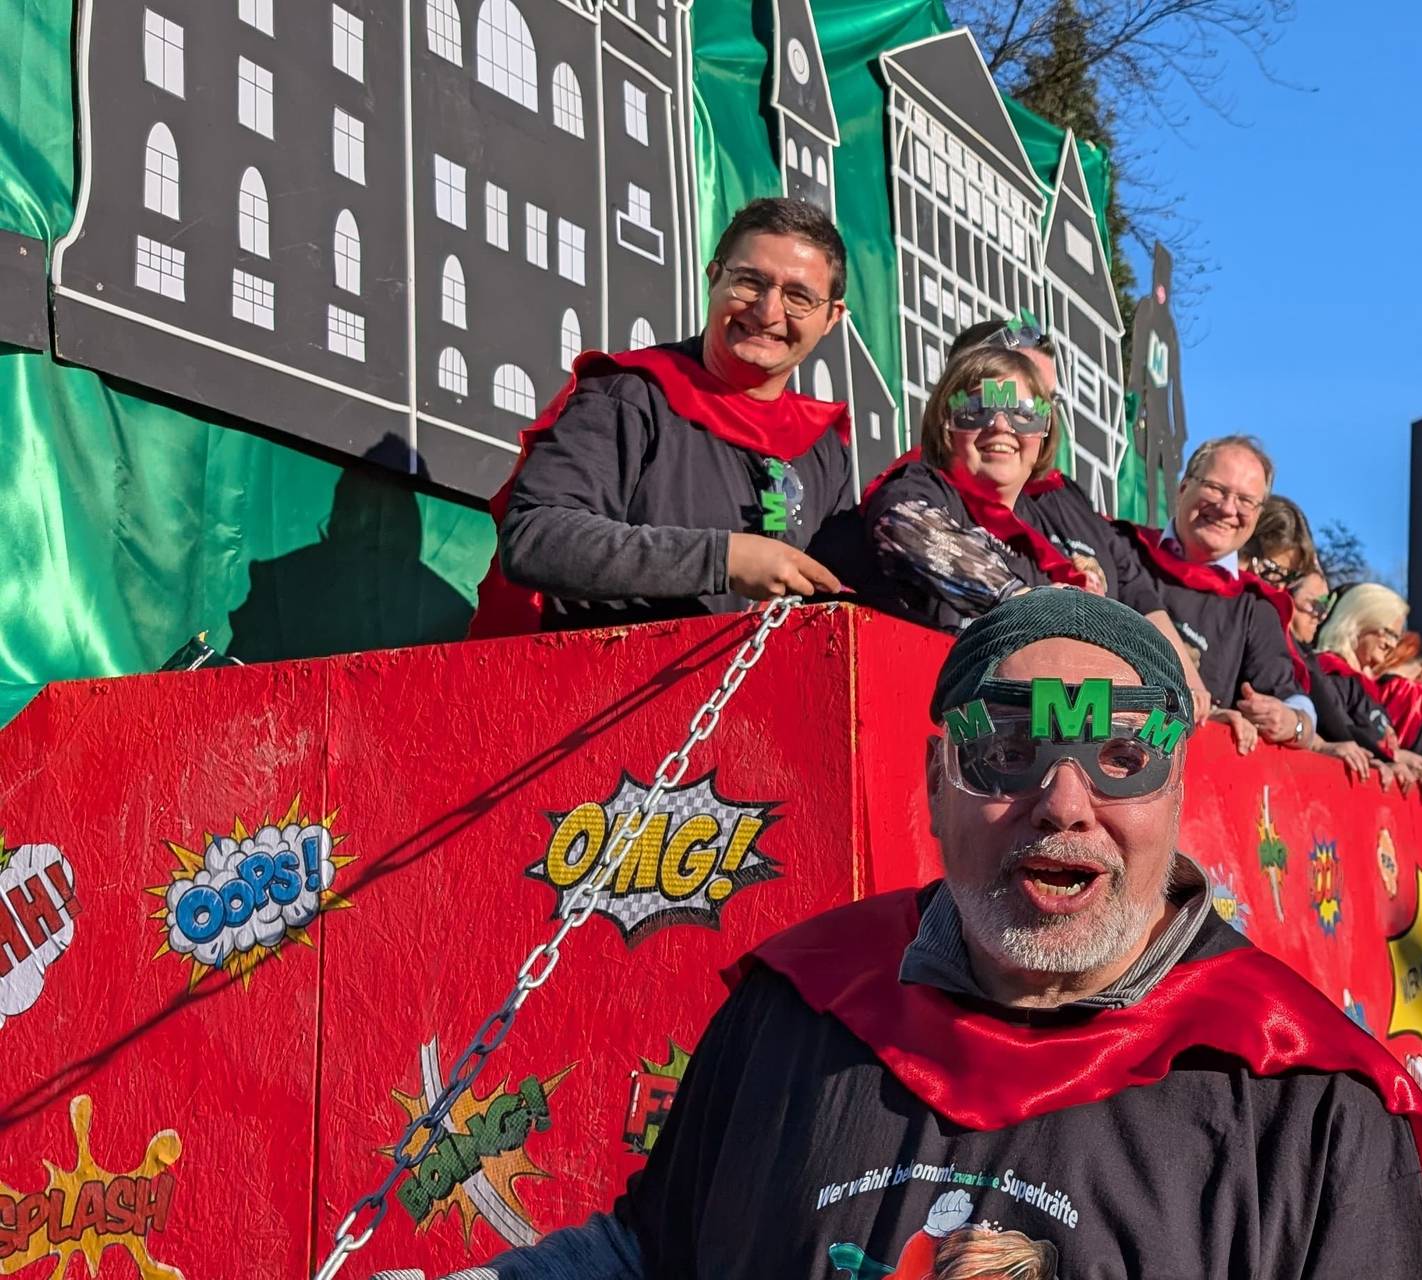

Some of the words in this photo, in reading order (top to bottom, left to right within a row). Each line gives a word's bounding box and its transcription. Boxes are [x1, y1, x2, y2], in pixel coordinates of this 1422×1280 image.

[981, 378, 1020, 408] M
[760, 489, 787, 531] M
[942, 698, 996, 745] M
[1031, 677, 1114, 742] M
[1136, 705, 1188, 756] M
[175, 835, 322, 945] OOPS!
[545, 801, 764, 902] OMG!
[396, 1075, 552, 1222] BOING!
[816, 1181, 848, 1211] Wer
[847, 1166, 892, 1198] wählt
[892, 1159, 955, 1186] bekommt
[952, 1172, 978, 1186] zwar
[1000, 1168, 1080, 1230] Superkräfte
